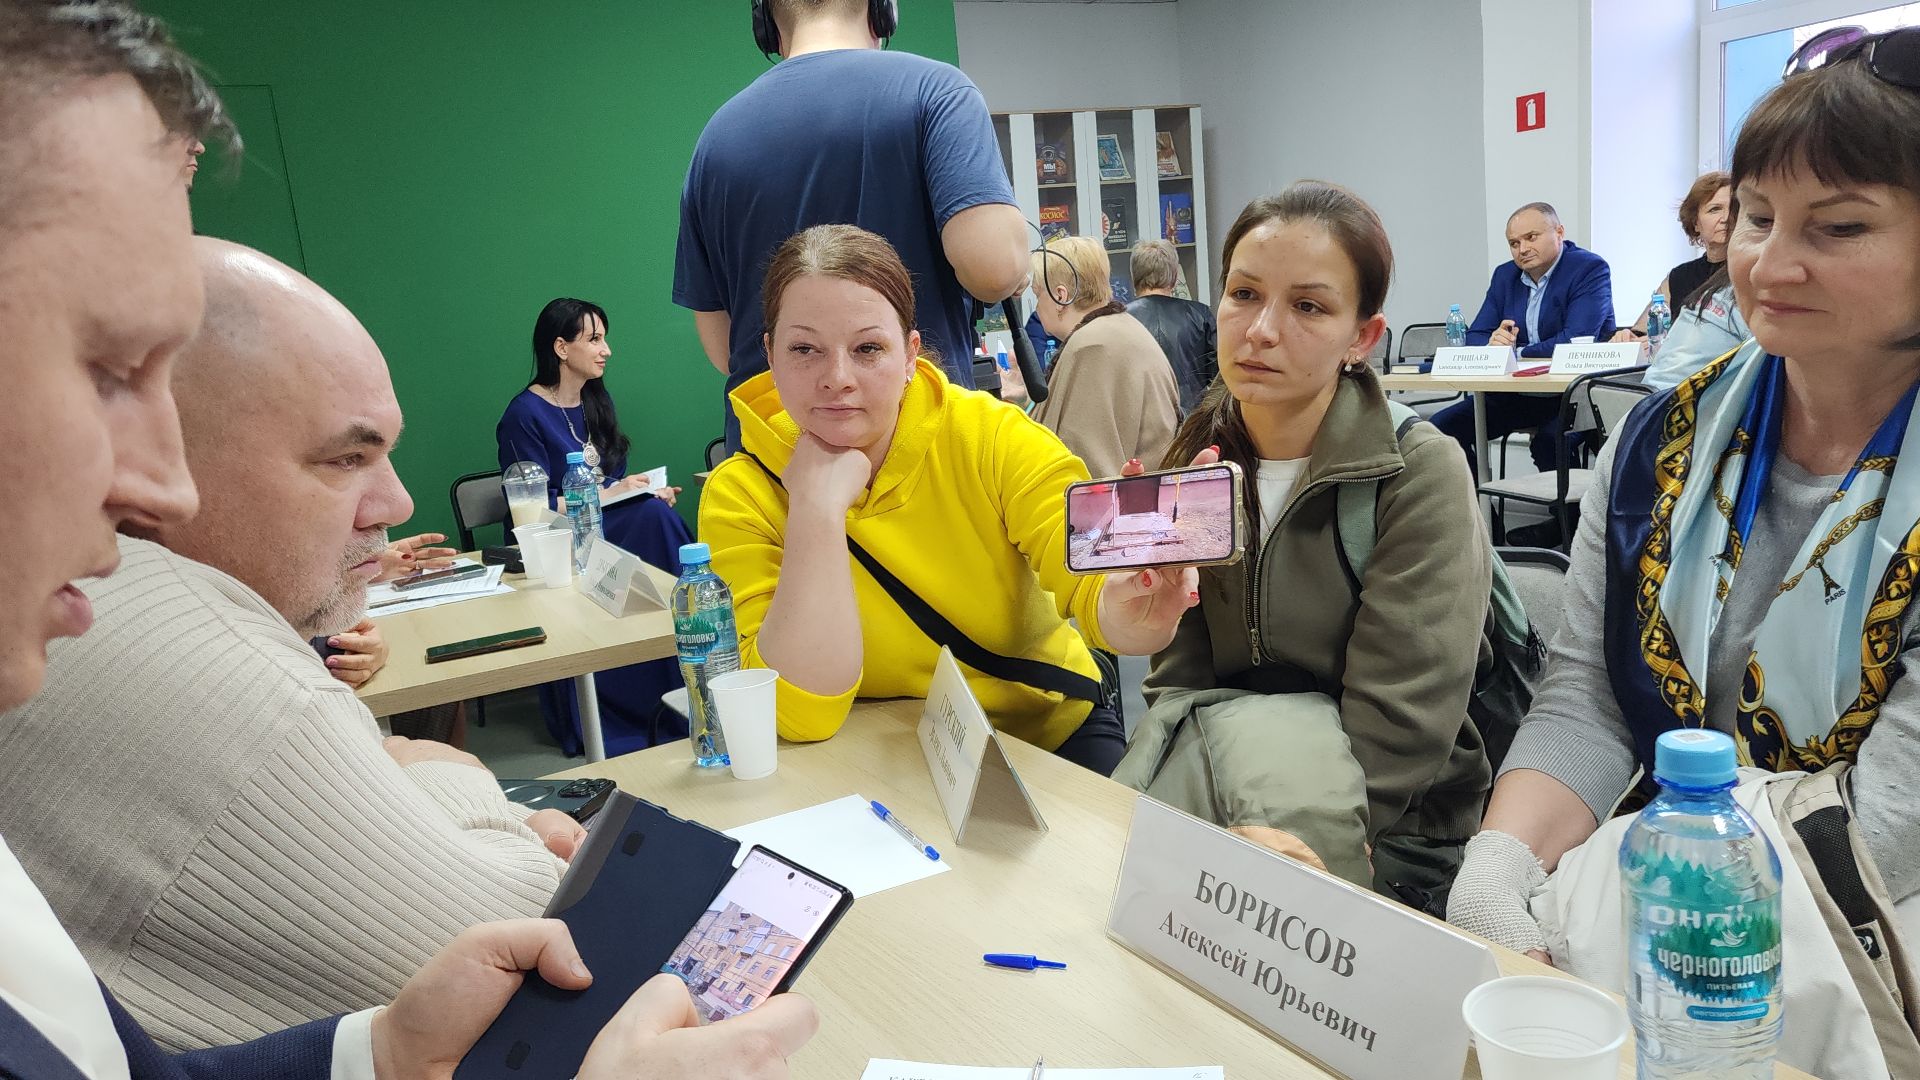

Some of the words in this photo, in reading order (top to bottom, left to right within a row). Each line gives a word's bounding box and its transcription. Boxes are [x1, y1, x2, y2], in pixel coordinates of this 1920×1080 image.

[1568, 351, 1621, 359] ПЕЧНИКОВА
[1825, 588, 1846, 605] PARIS
[1194, 870, 1357, 978] БОРИСОВ
[1159, 910, 1248, 978] Алексей
[1252, 960, 1377, 1052] Юрьевич
